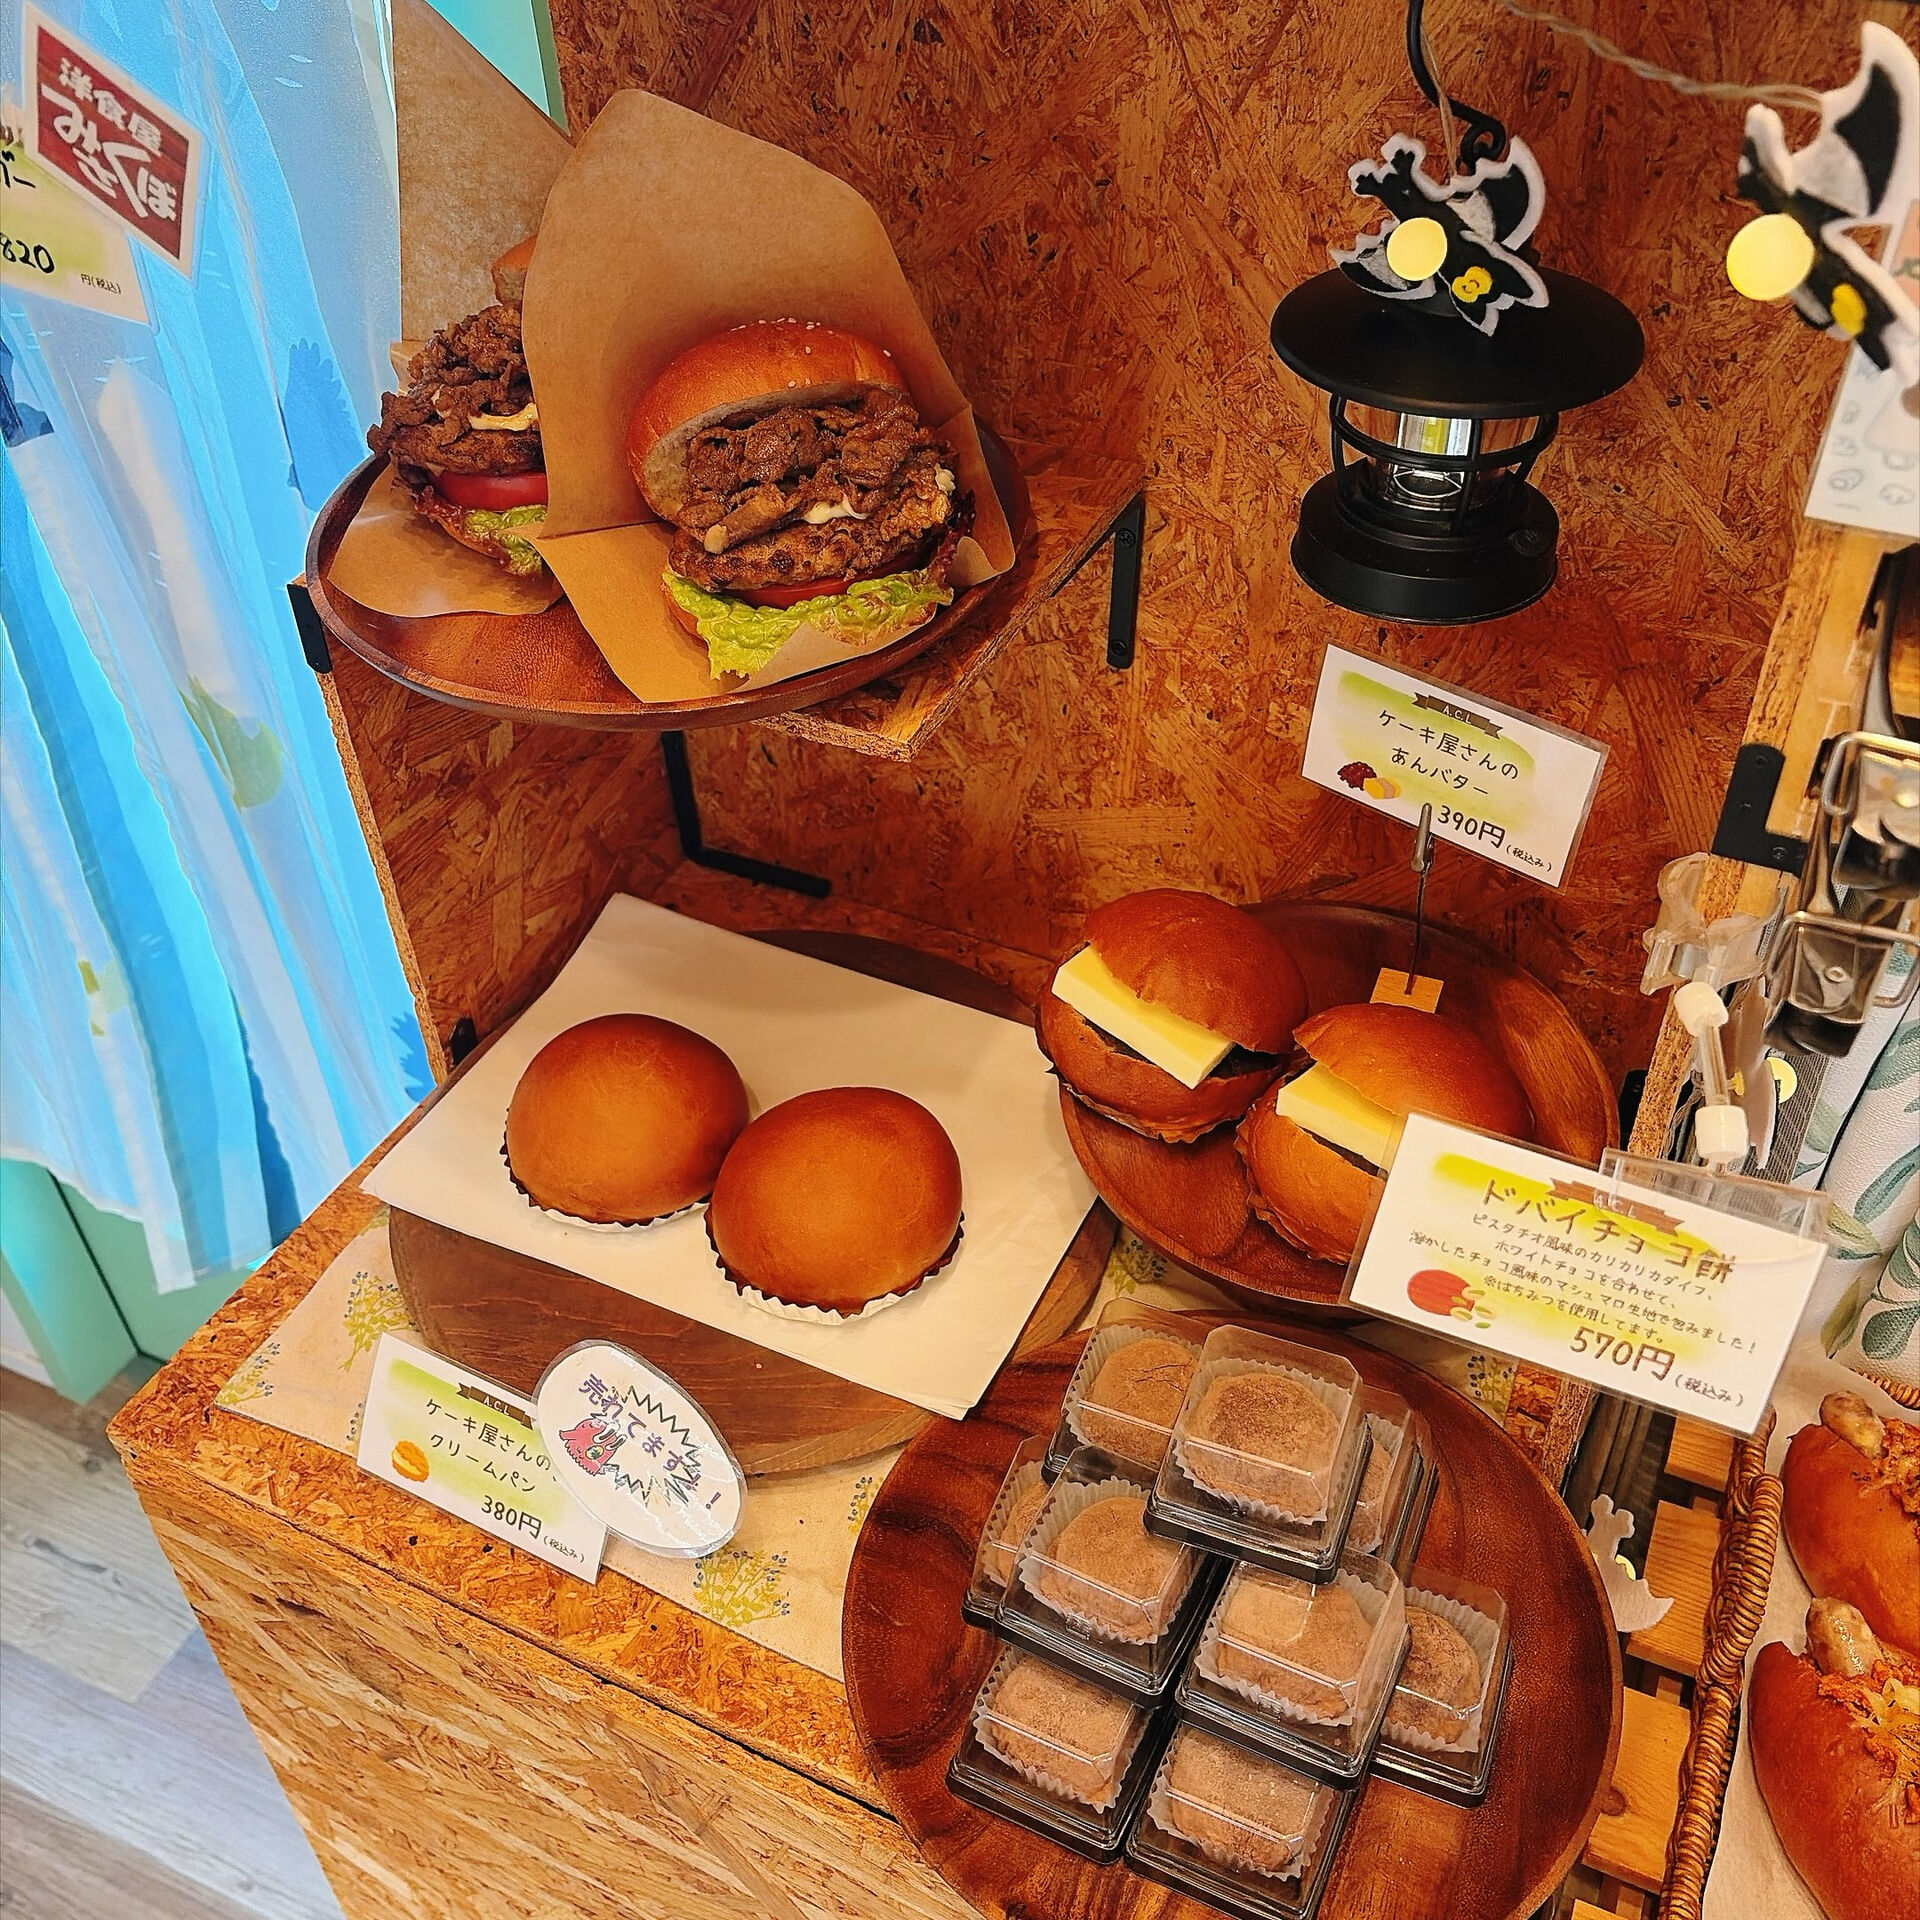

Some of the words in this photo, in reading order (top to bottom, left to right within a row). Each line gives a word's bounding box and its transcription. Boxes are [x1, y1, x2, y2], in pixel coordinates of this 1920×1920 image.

[58, 57, 162, 156] 洋食屋
[1378, 709, 1519, 781] ケーキ屋さんの
[1391, 746, 1489, 796] あんバター
[1437, 804, 1506, 850] 390円
[1505, 843, 1553, 873] （税込み）
[1472, 1213, 1715, 1302] ピスタチオ風味のカリカリカダイフ、
[1482, 1178, 1737, 1285] ドバイチョコ餅
[1494, 1240, 1677, 1310] ホワイトチョコを合わせて、
[1569, 1327, 1676, 1382] 570円
[1673, 1372, 1745, 1408] （税込み）
[430, 1434, 536, 1494] クリームパン
[481, 1494, 543, 1540] 380円
[542, 1535, 585, 1564] （税込み）
